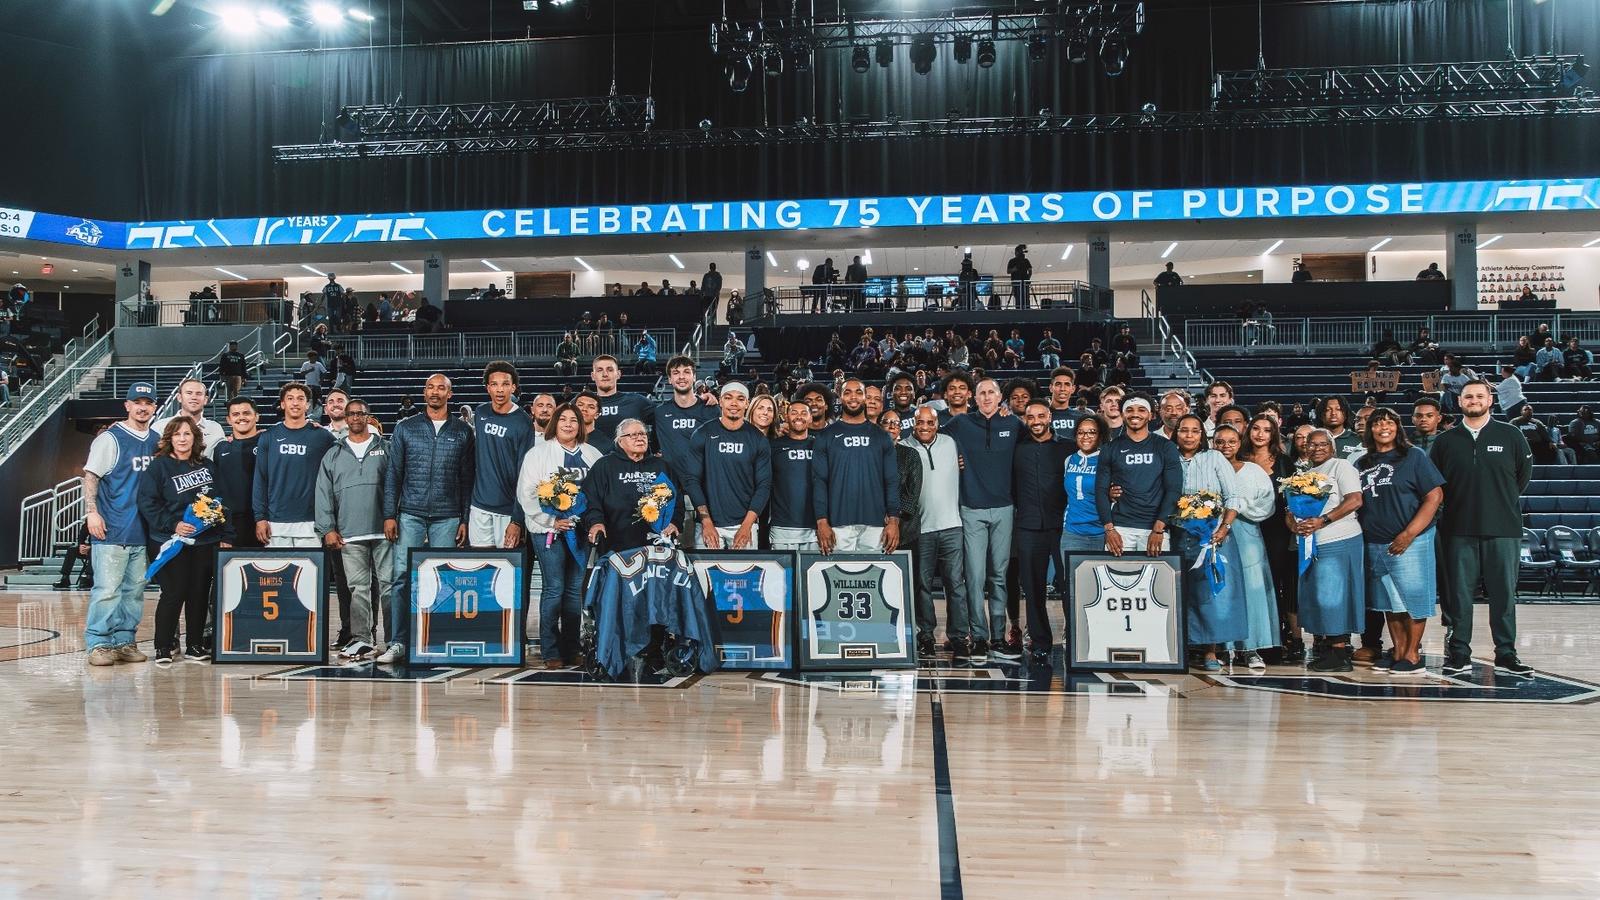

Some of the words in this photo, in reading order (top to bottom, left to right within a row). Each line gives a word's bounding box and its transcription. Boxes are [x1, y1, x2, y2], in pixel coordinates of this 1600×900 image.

[483, 202, 803, 237] CELEBRATING
[831, 199, 878, 227] 75
[908, 194, 1063, 224] YEARS
[1093, 191, 1152, 219] OF
[1184, 184, 1423, 217] PURPOSE
[288, 216, 328, 230] YEARS
[69, 227, 98, 244] ACU
[136, 385, 152, 394] CBU
[599, 406, 619, 416] BU
[484, 423, 508, 438] CBU
[672, 418, 697, 430] CBU
[900, 418, 915, 431] BU
[1052, 420, 1075, 430] CBU
[999, 430, 1011, 438] CBU
[719, 442, 744, 454] CBU
[843, 436, 870, 448] CBU
[279, 443, 307, 456] CBU
[369, 449, 385, 457] CBU
[788, 449, 814, 460] CBU
[132, 456, 155, 472] CB
[1125, 453, 1153, 465] CBU
[1075, 475, 1085, 500] 1
[259, 576, 283, 586] DANIELS
[833, 579, 876, 589] WILLIAMS
[262, 591, 279, 620] 5
[454, 590, 478, 619] 10
[727, 593, 744, 624] 3
[838, 592, 872, 620] 33
[1107, 598, 1147, 611] CBU
[1125, 615, 1132, 631] 1
